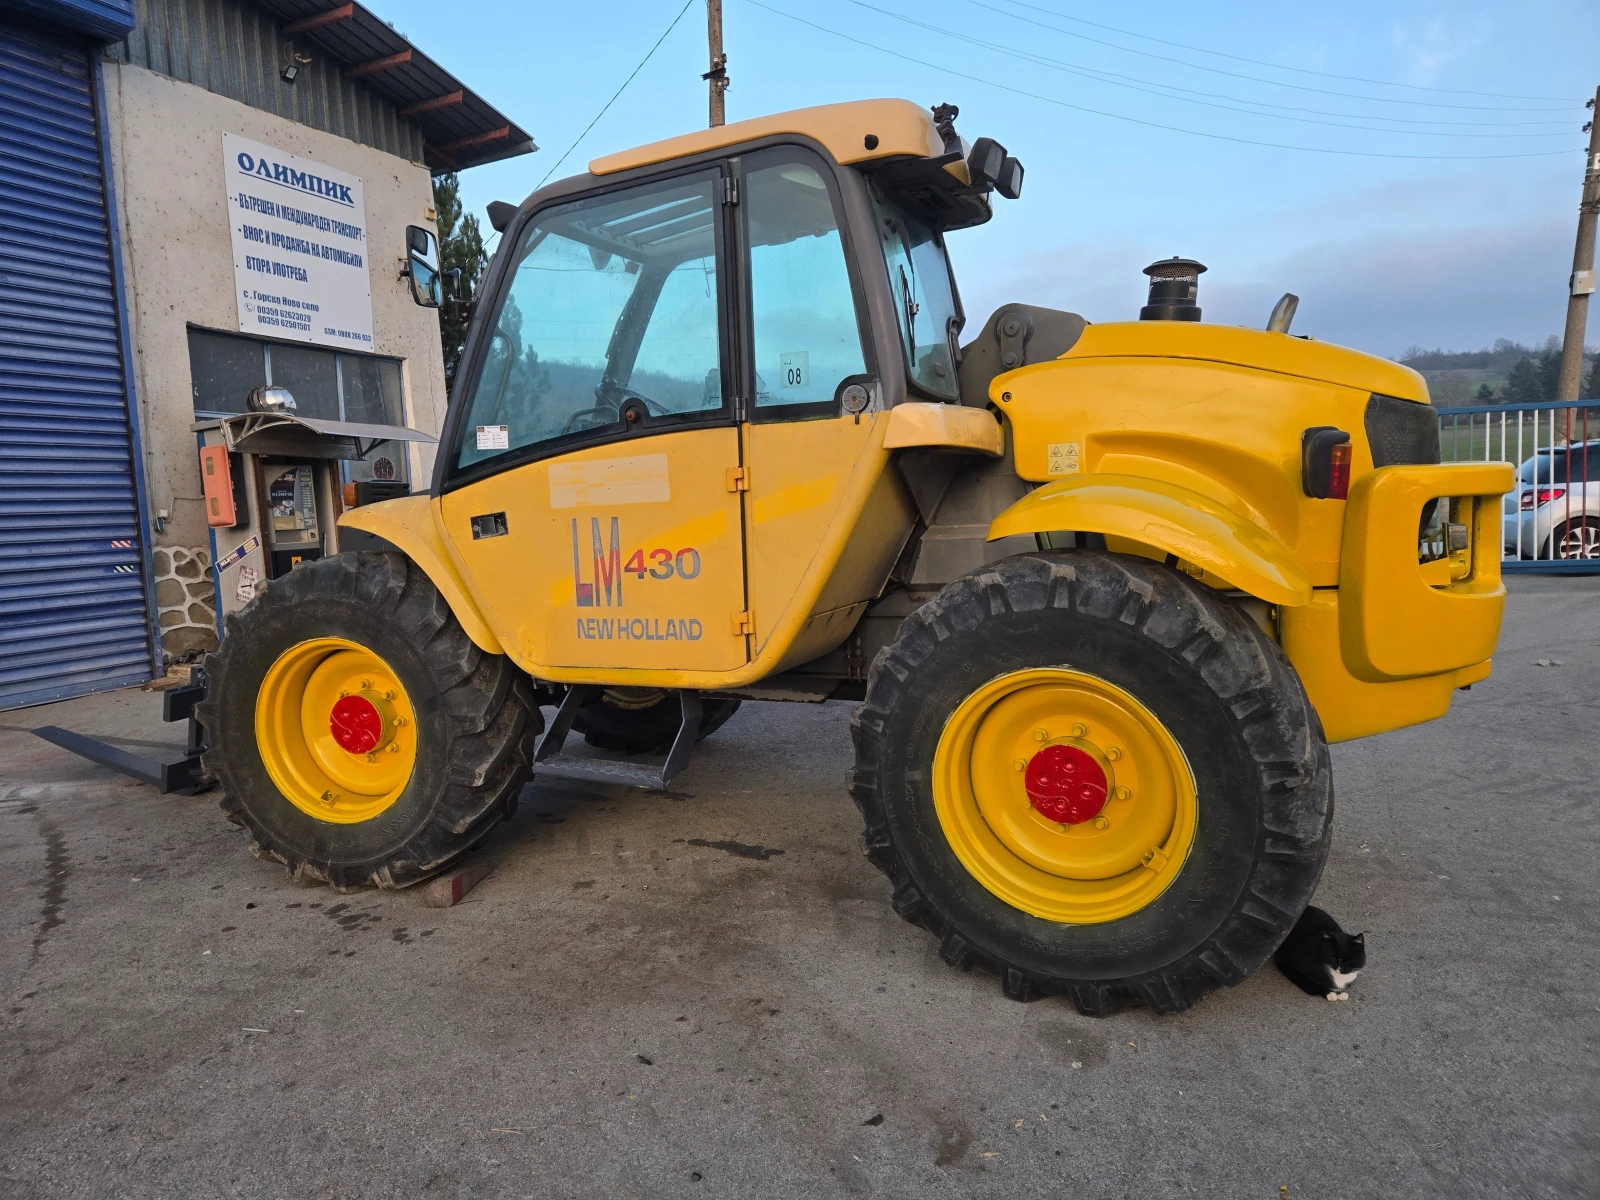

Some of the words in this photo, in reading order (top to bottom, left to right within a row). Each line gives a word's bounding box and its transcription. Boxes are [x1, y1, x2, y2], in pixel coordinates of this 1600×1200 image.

[237, 152, 354, 205] ОЛИМПИК
[238, 192, 275, 217] ВЪТРЕШЕН
[275, 203, 281, 219] И
[281, 205, 331, 233] МЕЖДУНАРОДЕН
[331, 220, 362, 242] ТРАНСПОРТ
[242, 224, 264, 244] ВНОС
[264, 231, 271, 245] И
[271, 231, 311, 255] ПРОДАЖБА
[311, 243, 321, 258] НА
[321, 245, 363, 269] АВТОМОБИЛИ
[245, 255, 272, 275] ВТОРА
[272, 261, 308, 283] УПОТРЕБА
[252, 290, 281, 304] Горско
[282, 297, 301, 309] Ново
[256, 305, 279, 317] 00359
[257, 314, 280, 326] 00359
[280, 319, 311, 332] 62501501
[577, 618, 614, 640] NEW
[617, 618, 703, 641] HOLLAND
